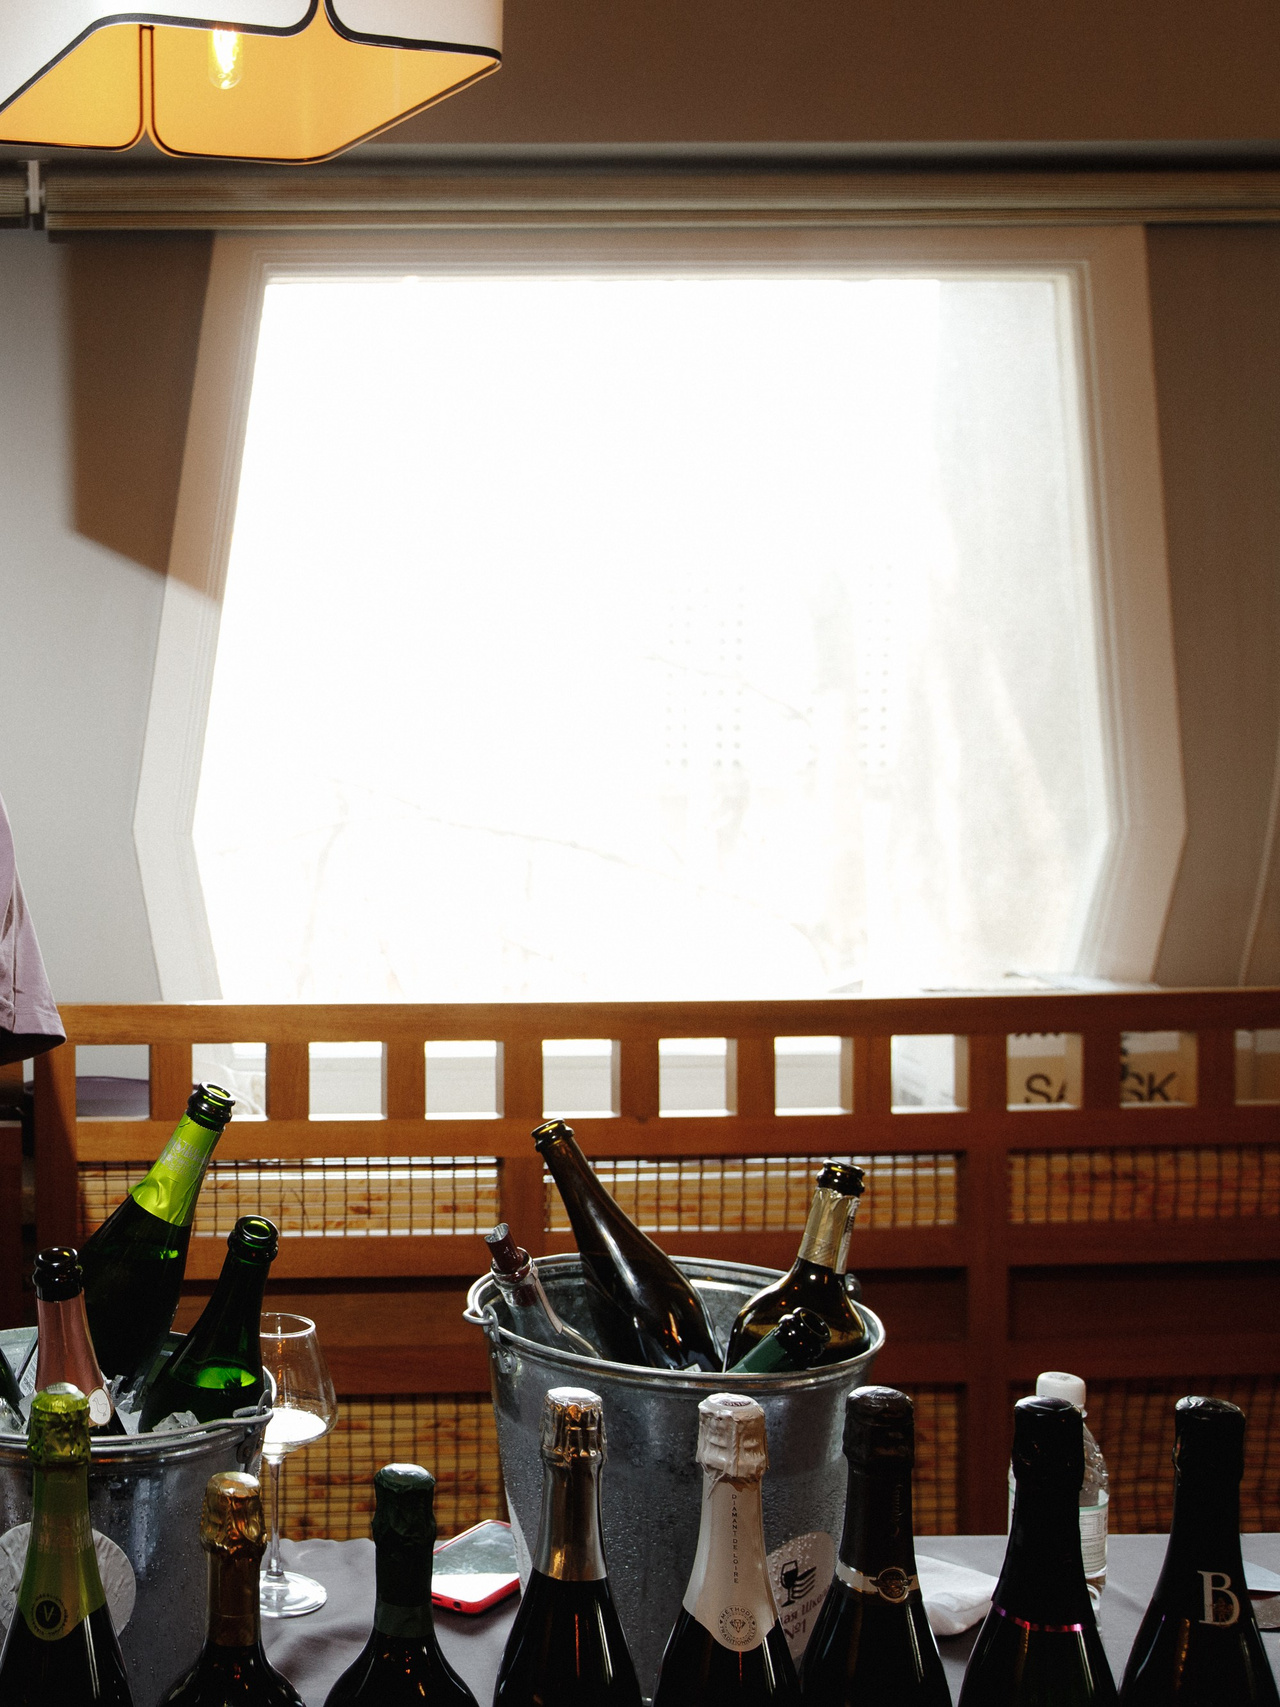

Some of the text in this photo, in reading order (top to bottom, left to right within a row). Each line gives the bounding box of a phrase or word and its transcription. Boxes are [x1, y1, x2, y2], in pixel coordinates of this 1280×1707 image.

[731, 1493, 739, 1536] DIAMANT
[732, 1538, 739, 1550] DE
[43, 1604, 55, 1622] V
[1197, 1570, 1240, 1627] B
